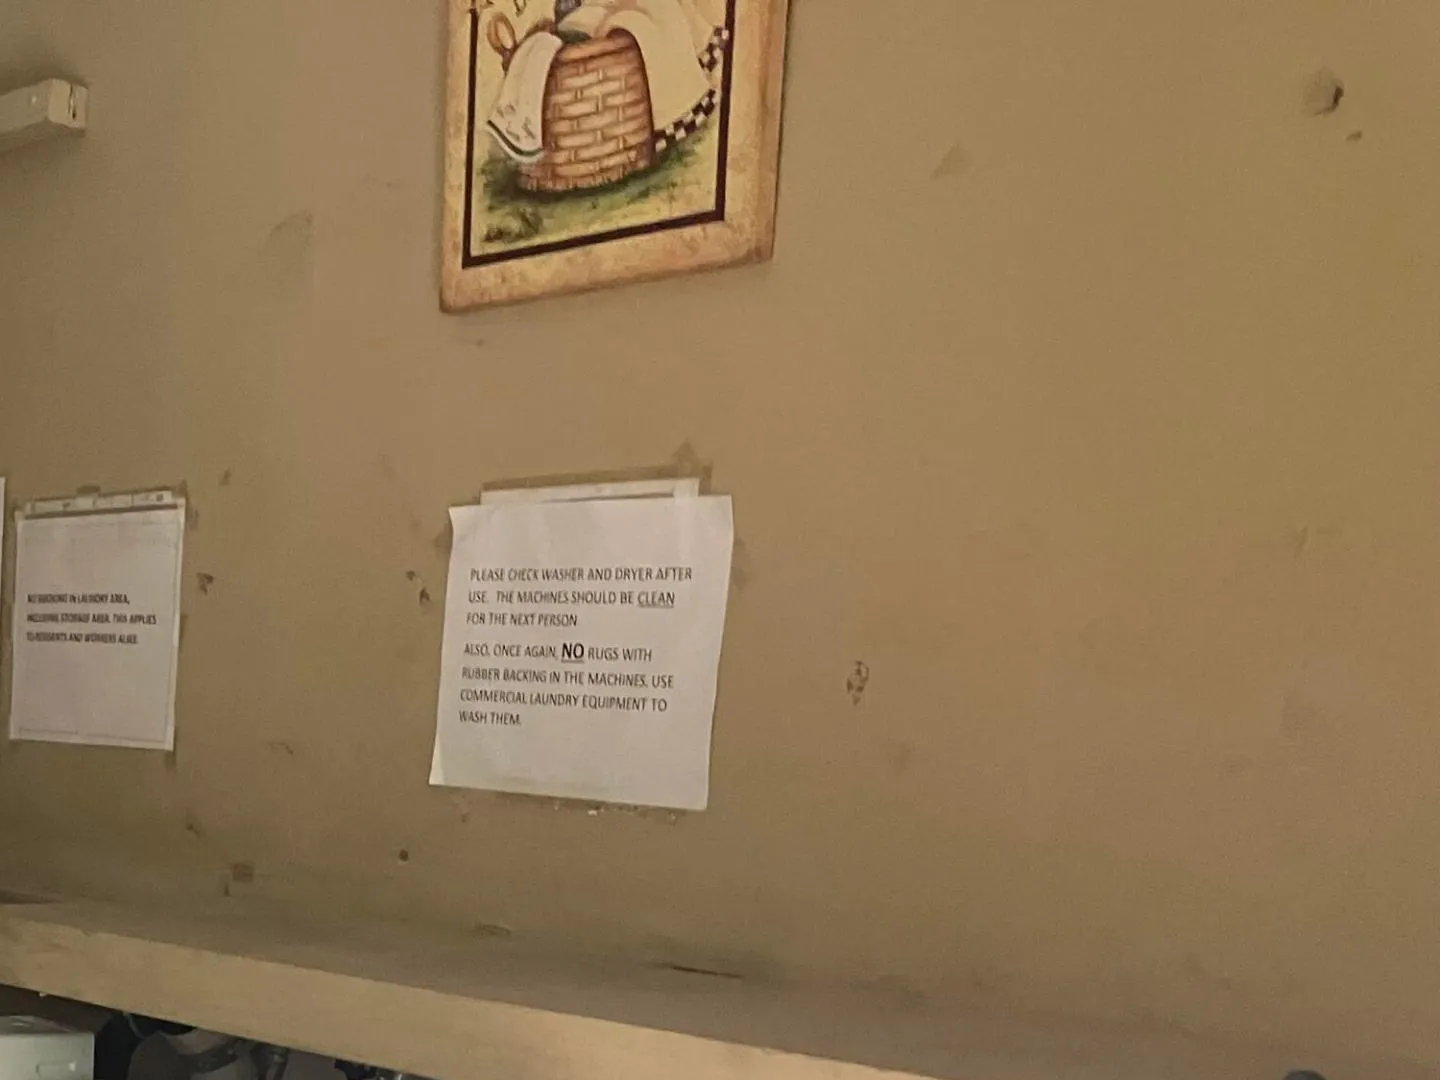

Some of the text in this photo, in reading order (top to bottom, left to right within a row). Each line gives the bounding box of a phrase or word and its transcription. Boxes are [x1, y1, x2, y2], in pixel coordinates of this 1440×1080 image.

[470, 567, 692, 581] PLEASE CHECK WASHER AND DRYER AFTER
[496, 590, 514, 604] THE
[517, 590, 569, 604] MACHINES
[571, 591, 616, 604] SHOULD
[620, 591, 634, 604] BE
[637, 591, 675, 607] CLEAN
[466, 612, 486, 625] FOR
[489, 612, 508, 625] THE
[510, 613, 535, 626] NEXT
[493, 643, 521, 657] ONCE
[561, 642, 585, 661] NO
[587, 646, 619, 661] RUGS
[622, 647, 652, 662] WITH
[462, 666, 500, 680] RUBBER
[503, 668, 547, 683] BACKING
[549, 670, 560, 683] IN
[564, 671, 584, 685] THE
[651, 674, 674, 689] USE
[460, 688, 668, 712] COMMERCIAL LAUNDRY EQUIPMENT TO
[458, 710, 487, 724] WASH
